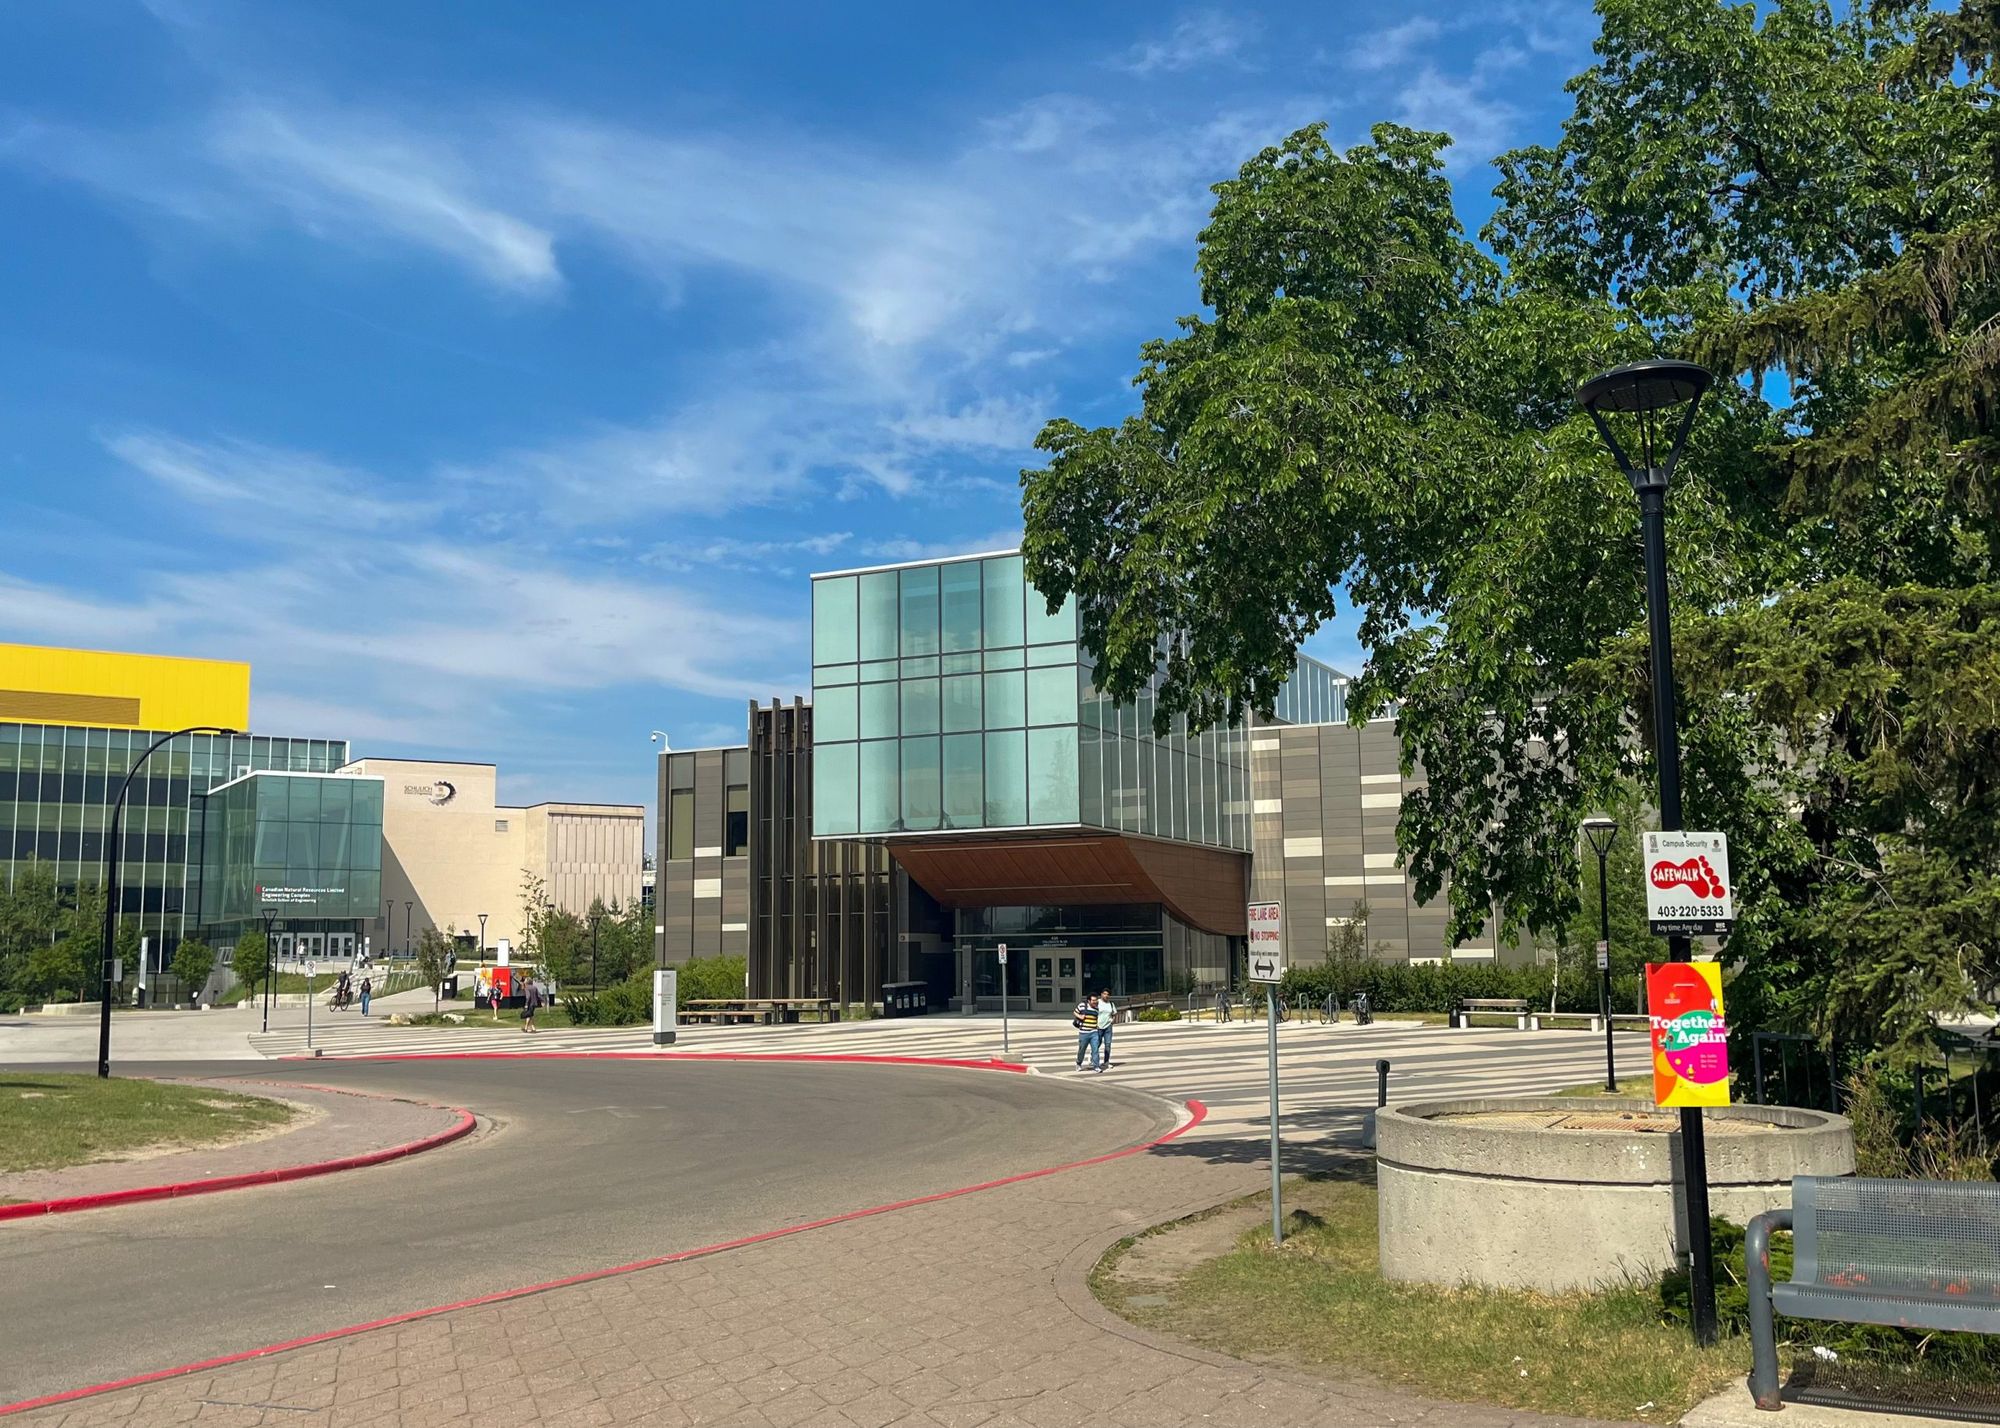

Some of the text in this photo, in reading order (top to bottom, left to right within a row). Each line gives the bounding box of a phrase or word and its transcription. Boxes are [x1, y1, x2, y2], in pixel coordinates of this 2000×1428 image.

[1662, 839, 1684, 848] Campus
[1685, 839, 1708, 849] Security
[1653, 867, 1699, 882] SAFEWALK
[1657, 923, 1667, 933] Any
[1682, 923, 1692, 932] Any
[1693, 923, 1703, 932] day
[1649, 1015, 1725, 1032] Together
[1677, 1029, 1727, 1046] Again
